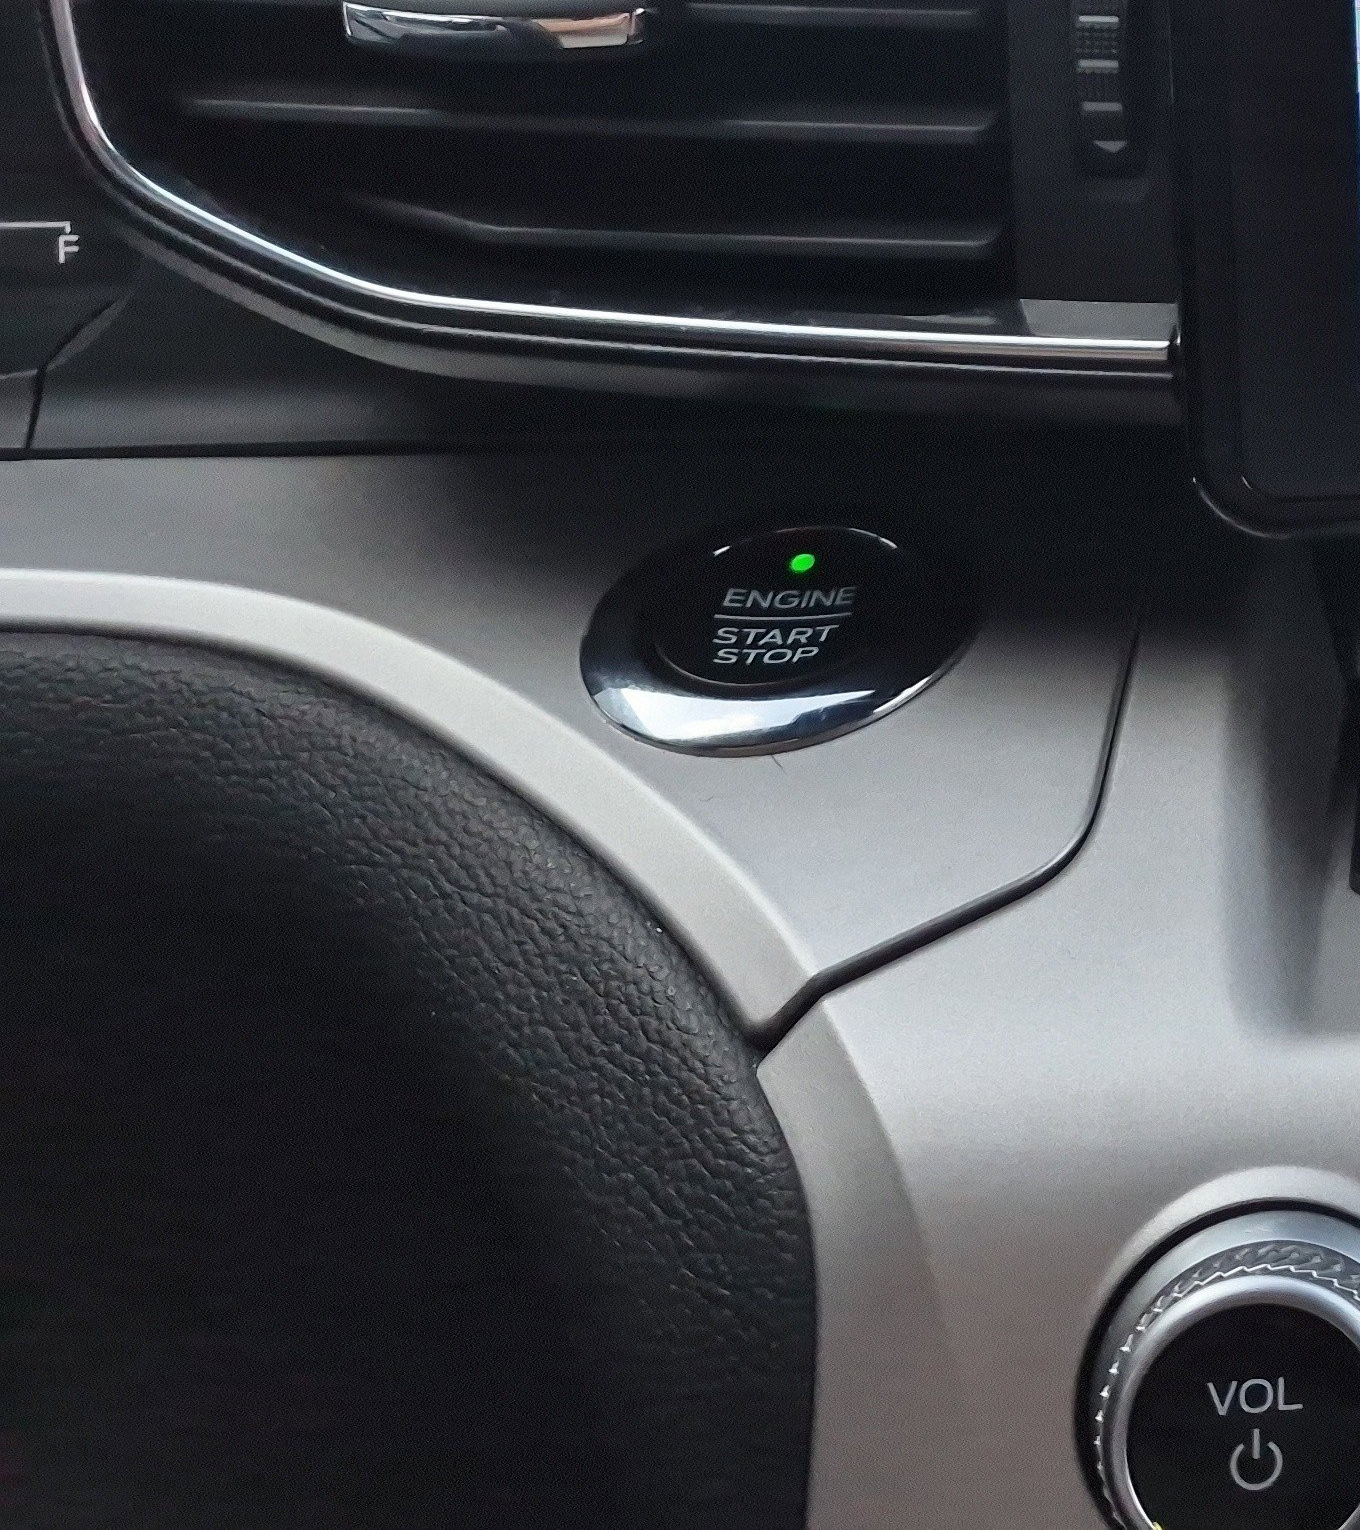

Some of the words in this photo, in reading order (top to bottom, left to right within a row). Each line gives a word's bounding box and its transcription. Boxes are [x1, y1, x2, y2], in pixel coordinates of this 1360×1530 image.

[57, 233, 79, 264] F
[722, 586, 857, 609] ENGINE
[713, 624, 839, 646] START
[713, 646, 819, 665] STOP
[1207, 1376, 1304, 1416] VOL
